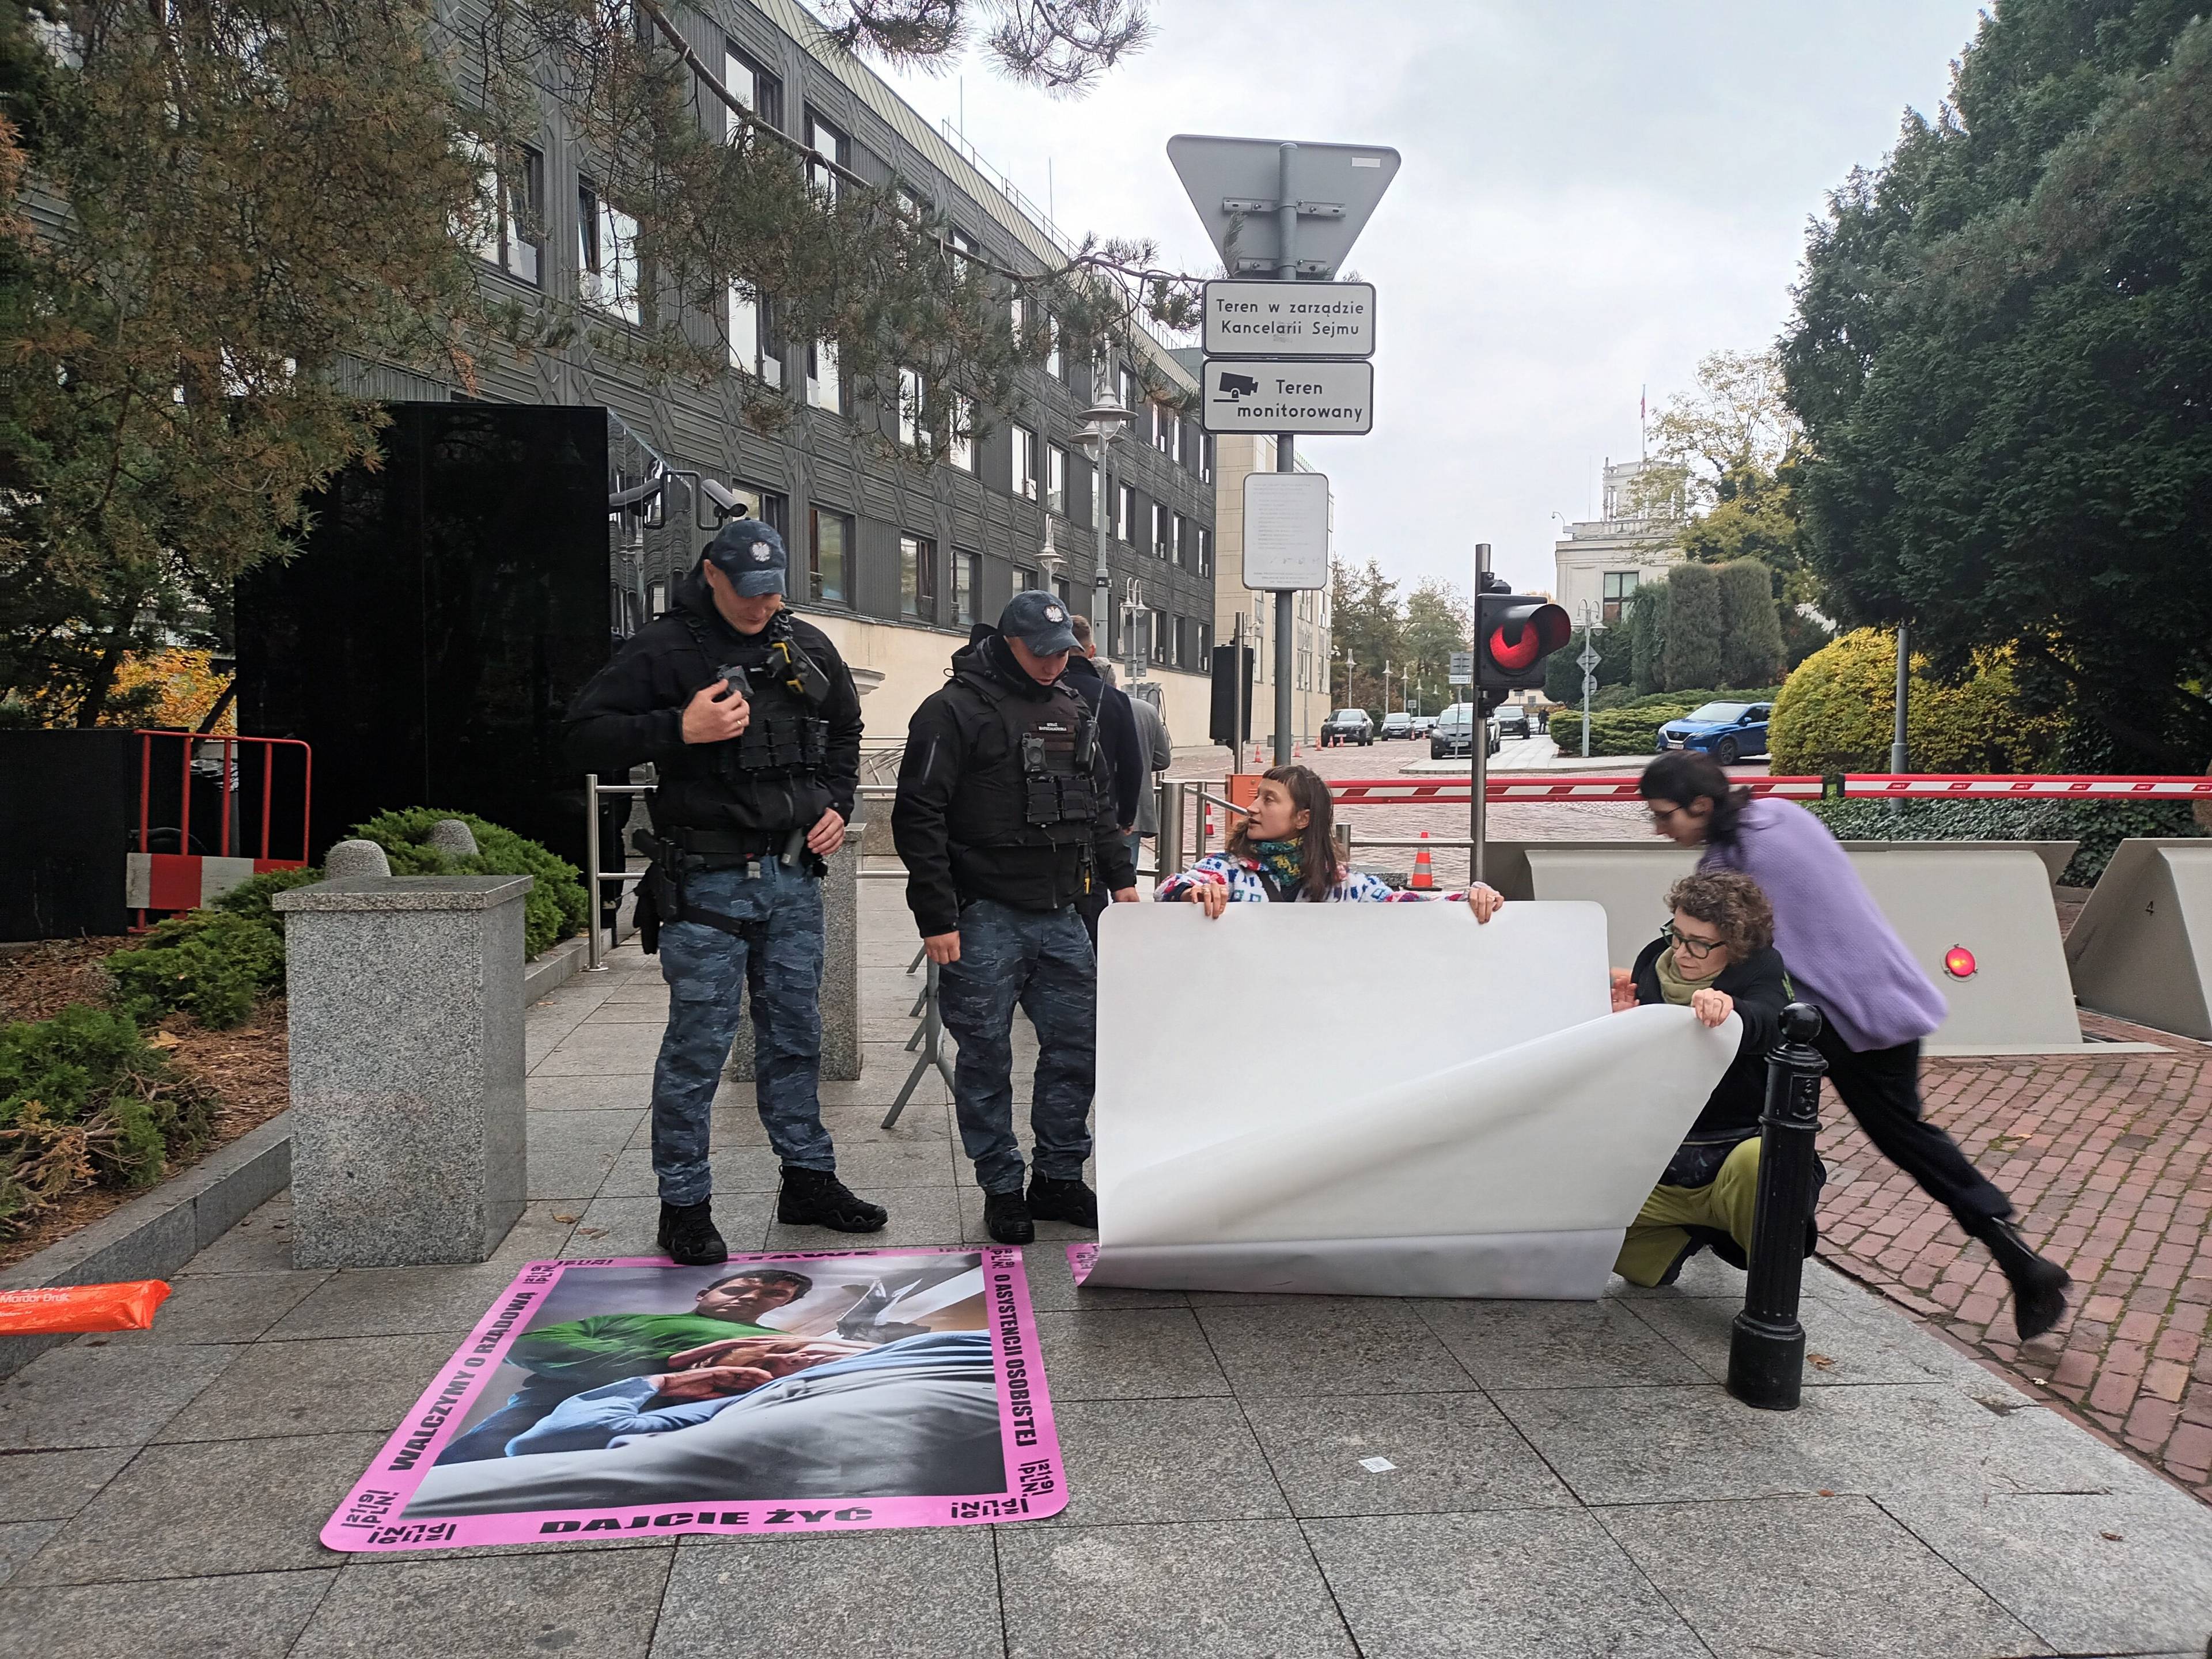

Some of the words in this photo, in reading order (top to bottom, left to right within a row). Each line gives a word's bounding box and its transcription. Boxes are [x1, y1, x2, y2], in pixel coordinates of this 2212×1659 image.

[1217, 299, 1258, 313] Teren
[1268, 303, 1280, 313] w
[1290, 301, 1364, 317] zarządzie
[1222, 320, 1301, 334] Kancelarii
[1312, 321, 1359, 338] Sejmu
[1276, 379, 1323, 395] Teren
[1237, 403, 1362, 422] monitorowany
[2145, 900, 2154, 916] 4
[994, 1274, 1010, 1282] O
[473, 1291, 539, 1354] RZĄDOWĄ
[995, 1284, 1022, 1356] ASYSTENCJI
[464, 1357, 486, 1367] O
[1005, 1358, 1037, 1447] OSOBISTEJ
[388, 1370, 476, 1471] WALCZYMY
[539, 1512, 749, 1533] DAJCIE
[763, 1506, 873, 1524] ŻYĆ
